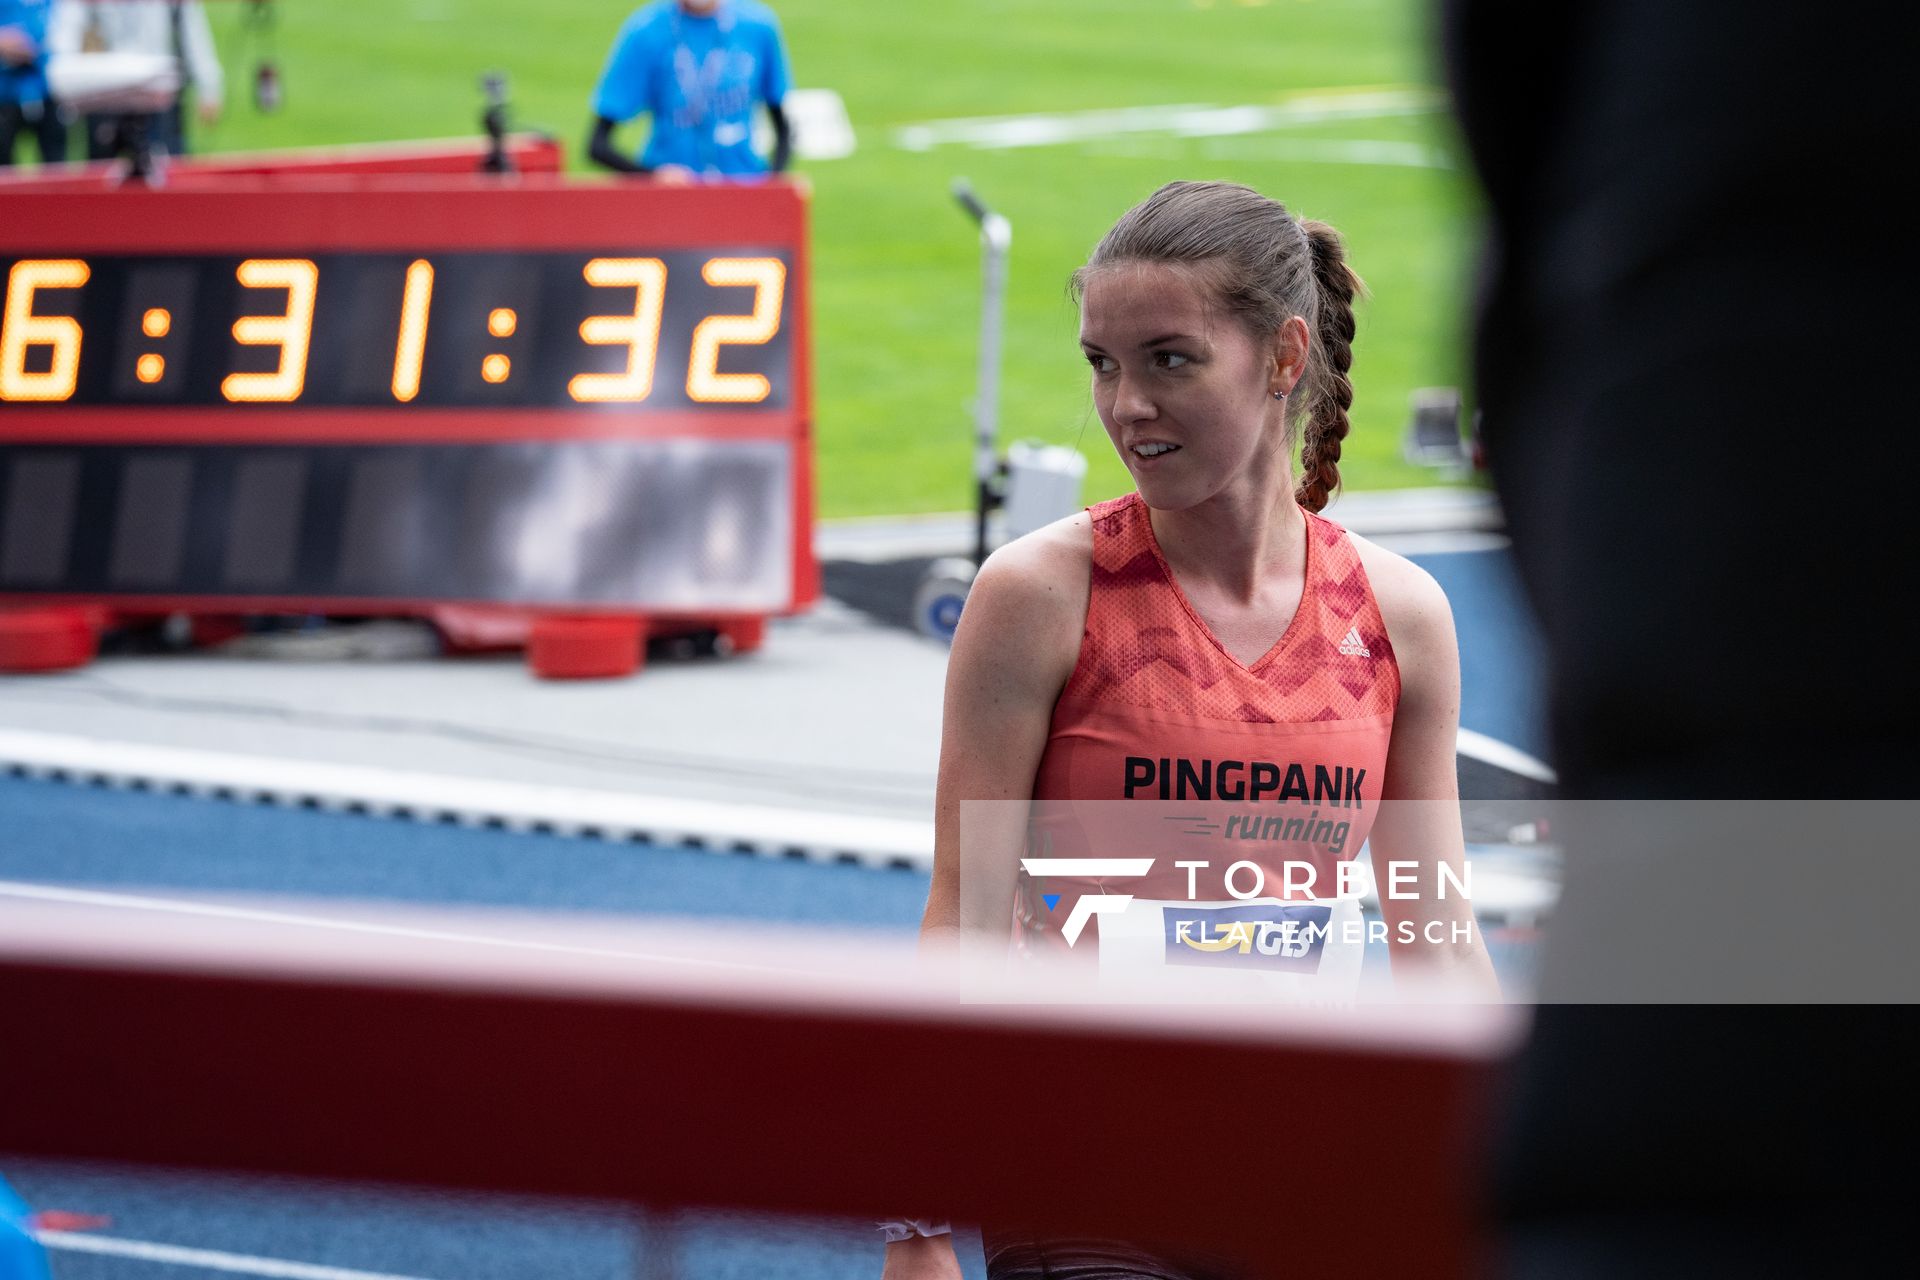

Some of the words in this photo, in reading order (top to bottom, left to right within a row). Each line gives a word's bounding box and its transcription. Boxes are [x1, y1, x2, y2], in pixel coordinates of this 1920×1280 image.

[1339, 643, 1371, 658] adidas
[1124, 756, 1367, 810] PINGPANK
[1224, 811, 1351, 854] running
[1256, 921, 1312, 959] GLS
